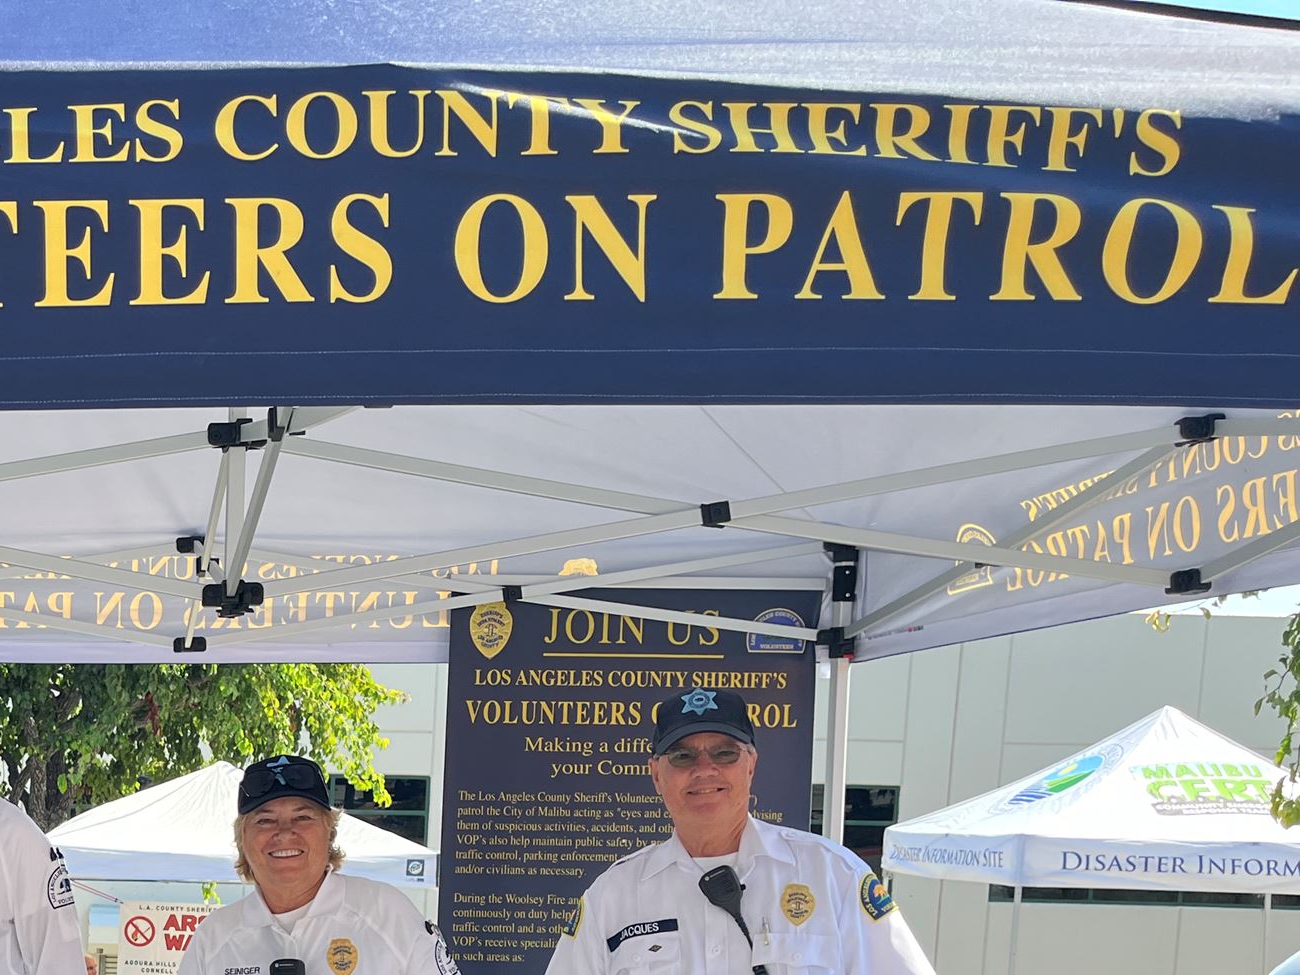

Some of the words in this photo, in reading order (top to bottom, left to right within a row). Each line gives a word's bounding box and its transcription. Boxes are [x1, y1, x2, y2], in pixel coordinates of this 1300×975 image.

[214, 88, 637, 162] COUNTY
[669, 99, 1181, 177] SHERIFF'S
[453, 193, 657, 304] ON
[713, 190, 1298, 306] PATROL
[543, 608, 645, 645] JOIN
[667, 608, 721, 645] US
[474, 668, 511, 686] LOS
[515, 669, 603, 687] ANGELES
[608, 670, 688, 688] COUNTY
[691, 671, 788, 689] SHERIFF'S
[465, 699, 641, 726] VOLUNTEERS
[524, 736, 593, 756] Making
[599, 742, 609, 753] a
[551, 762, 593, 778] your
[1142, 763, 1263, 779] MALIBU
[1146, 778, 1273, 801] CERT
[458, 790, 476, 801] The
[478, 791, 495, 802] Los
[499, 791, 535, 804] Angeles
[537, 792, 570, 805] County
[574, 792, 612, 803] Sheriff's
[457, 806, 484, 818] patrol
[503, 807, 522, 819] City
[538, 807, 571, 817] Malibu
[573, 808, 601, 820] acting
[644, 808, 661, 818] and
[456, 821, 479, 831] them
[494, 822, 542, 833] suspicious
[544, 822, 589, 834] activities,
[591, 823, 637, 834] accidents,
[639, 823, 656, 833] and
[456, 835, 487, 846] VOP's
[489, 835, 508, 846] also
[510, 836, 530, 848] help
[532, 836, 572, 847] maintain
[575, 837, 604, 849] public
[606, 838, 633, 850] safety
[455, 849, 483, 860] traffic
[523, 851, 558, 863] parking
[560, 852, 618, 862] enforcement
[890, 844, 922, 862] DISASTER
[922, 846, 979, 866] INFORMATION
[983, 848, 1004, 868] SITE
[1061, 850, 1187, 874] DISASTER
[1198, 854, 1300, 877] INFORM
[454, 864, 484, 875] and/or
[486, 864, 525, 875] civilians
[454, 892, 486, 905] During
[488, 893, 503, 904] the
[505, 893, 544, 907] Woolsey
[547, 894, 566, 905] Fire
[452, 908, 511, 920] continuously
[528, 909, 549, 921] duty
[452, 922, 480, 933] traffic
[483, 923, 515, 934] control
[517, 923, 534, 934] and
[619, 922, 660, 941] JACQUES
[452, 936, 482, 947] VOP's
[485, 938, 518, 948] receive
[463, 951, 484, 961] such
[224, 966, 261, 975] SEINIGER
